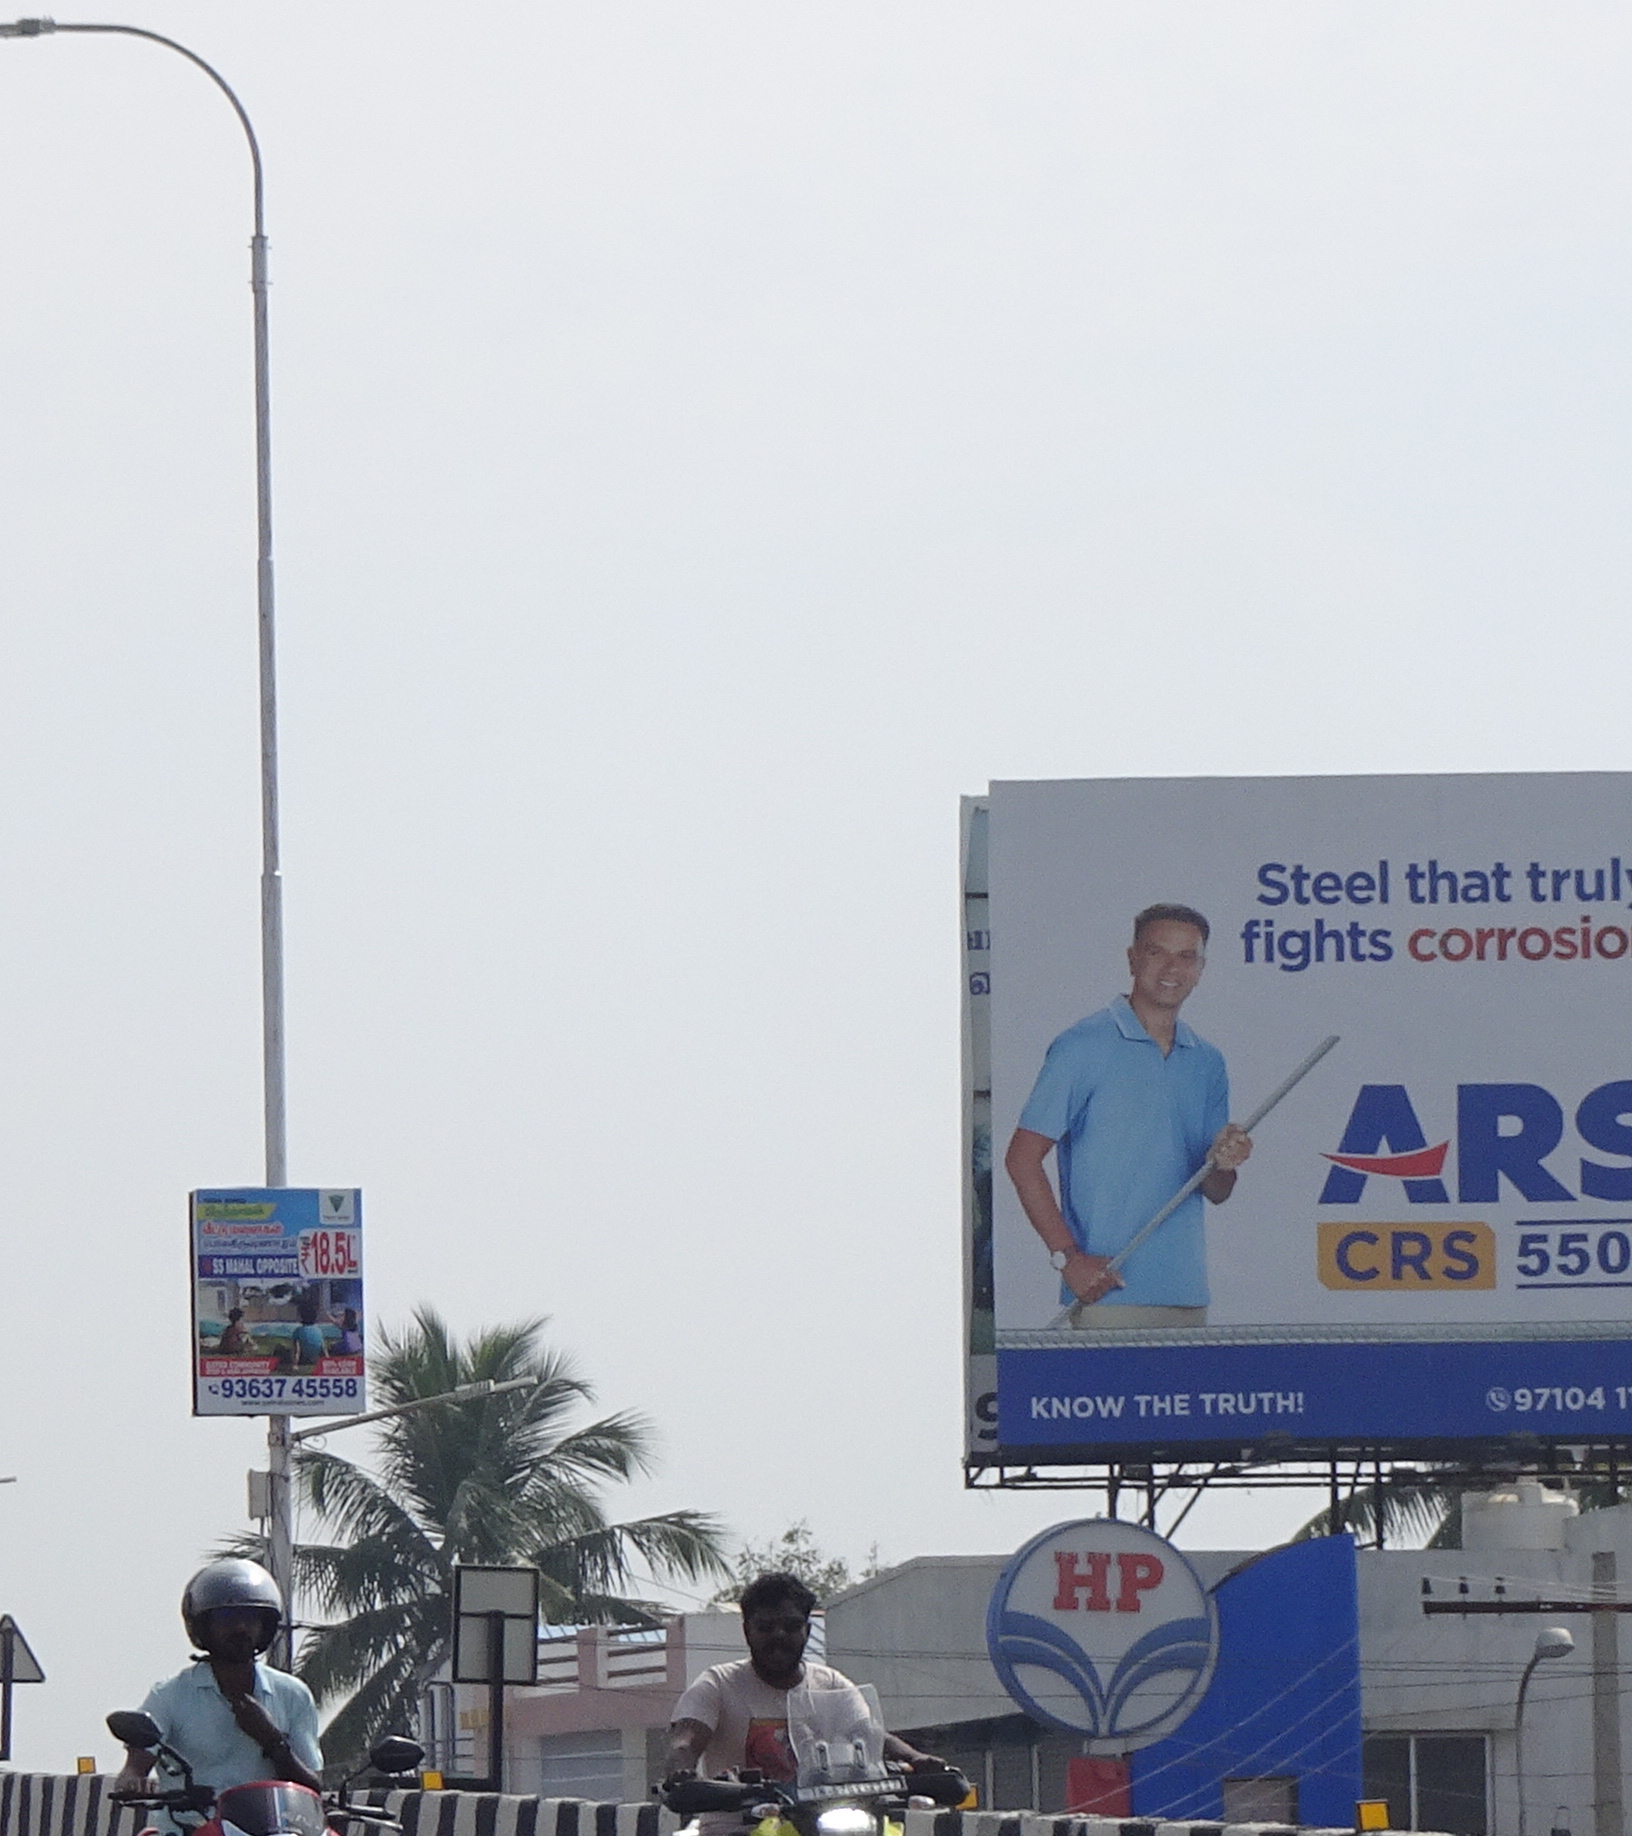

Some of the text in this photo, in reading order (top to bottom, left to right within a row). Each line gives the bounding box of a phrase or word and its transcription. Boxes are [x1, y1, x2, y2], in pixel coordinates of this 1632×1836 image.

[1256, 859, 1389, 907] Steel
[1404, 859, 1511, 905] that
[1240, 918, 1393, 973] fights
[1335, 1230, 1480, 1282] CRS
[220, 1378, 357, 1398] 93637 45558
[1031, 1391, 1305, 1419] KNOW THE TRUTH!
[1514, 1386, 1606, 1412] 97104
[1052, 1551, 1165, 1614] HP
